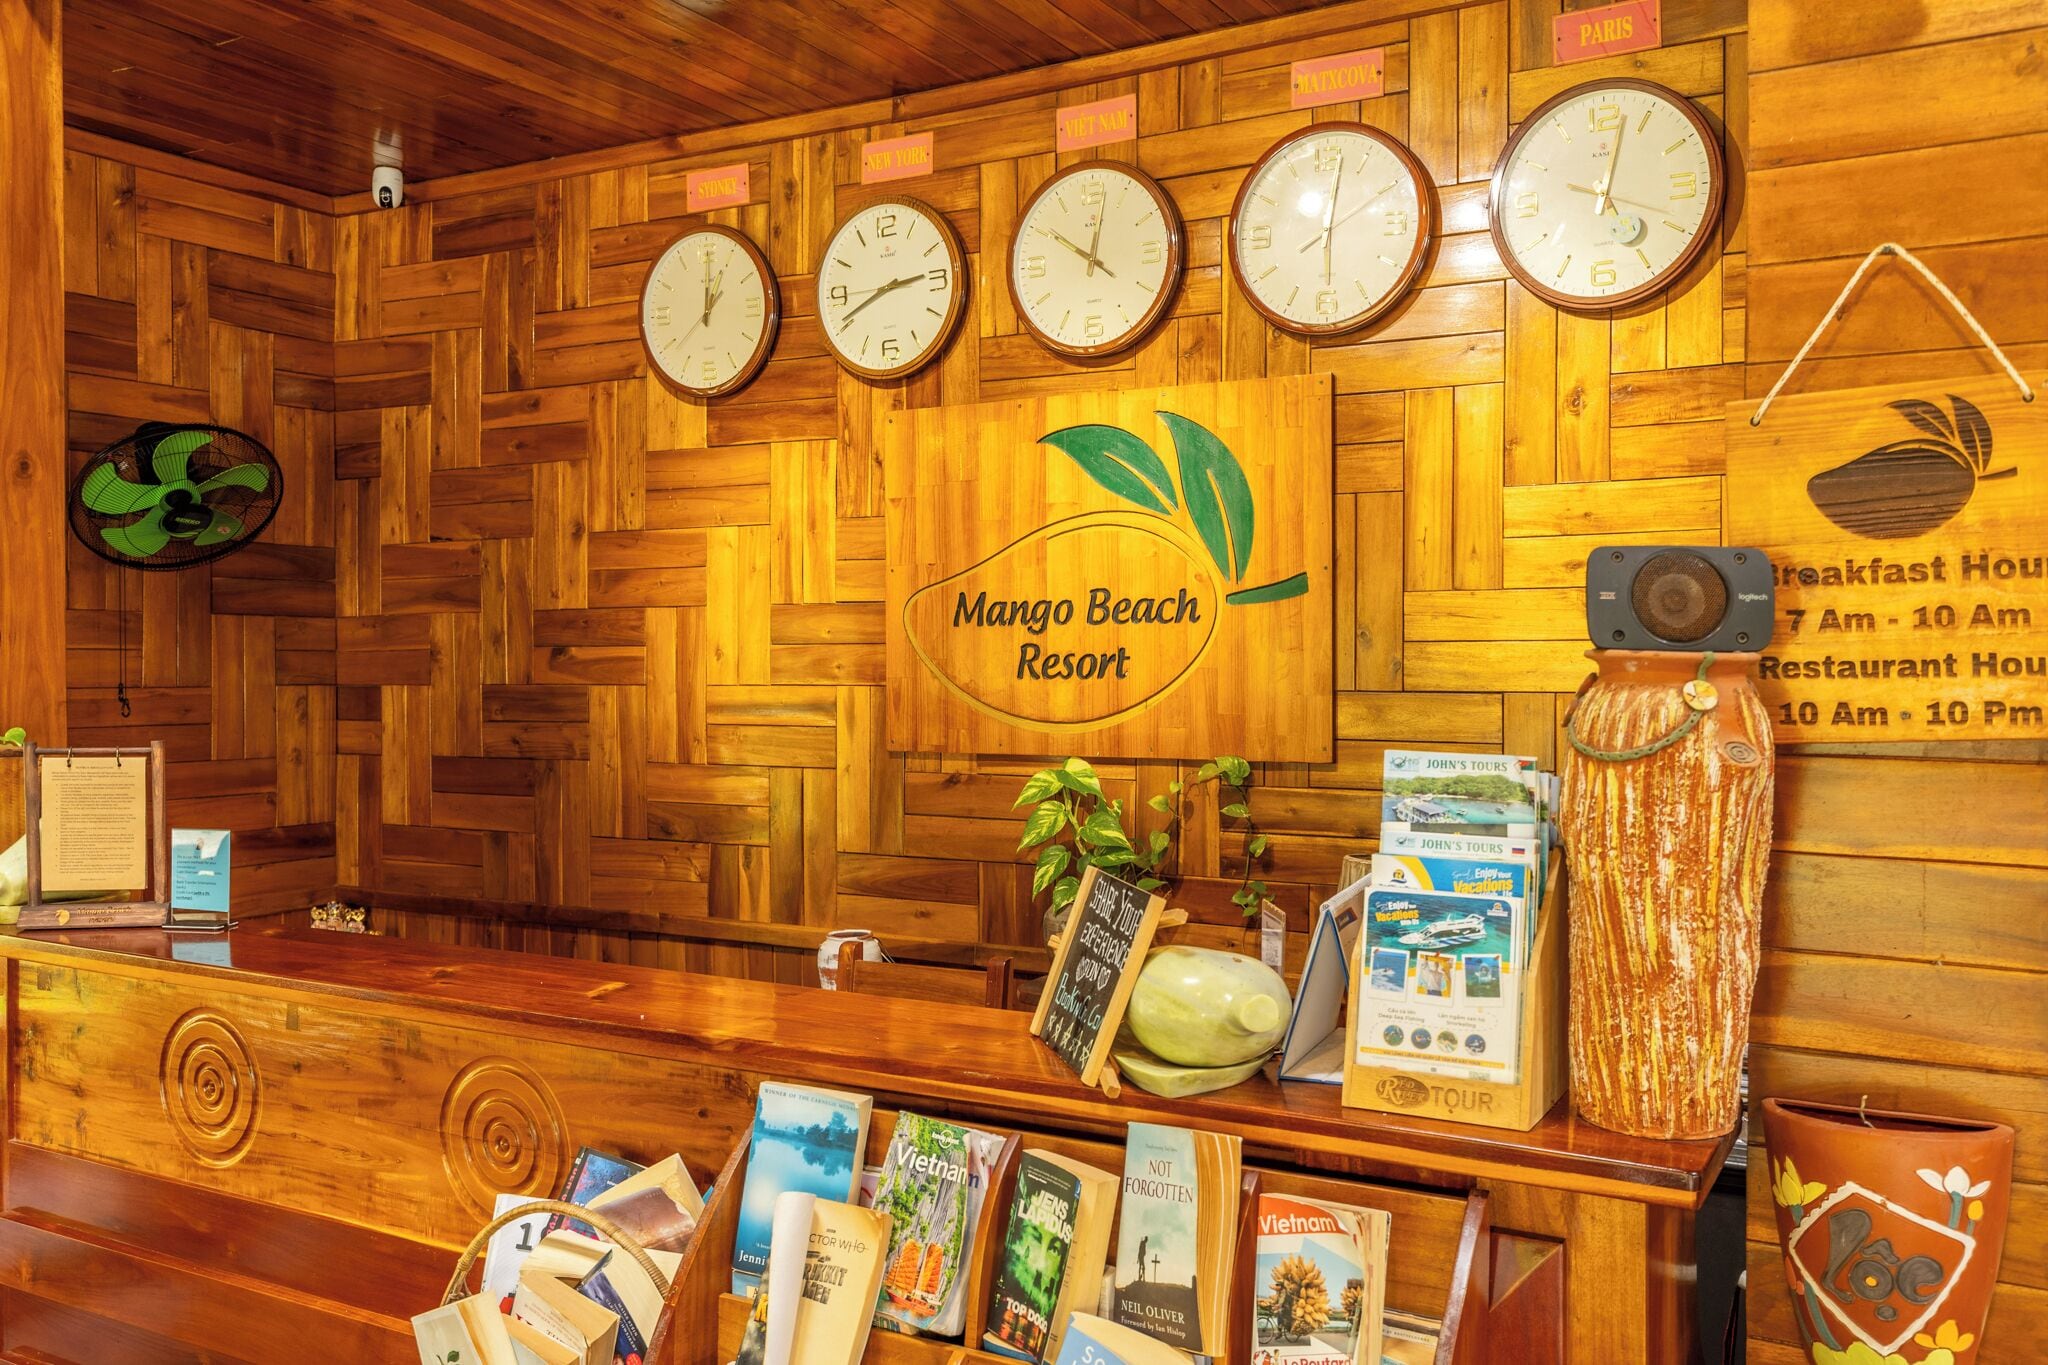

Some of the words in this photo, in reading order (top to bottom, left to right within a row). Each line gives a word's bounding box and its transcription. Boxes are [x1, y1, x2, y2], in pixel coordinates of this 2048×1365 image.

[1579, 15, 1633, 48] PARIS
[1297, 63, 1379, 95] MATXCOVA
[1099, 108, 1128, 133] NAM
[1588, 103, 1621, 133] 12
[866, 151, 893, 172] NEW
[895, 145, 928, 167] YORK
[698, 177, 737, 199] SYDNEY
[1669, 171, 1697, 200] 3
[876, 214, 898, 239] 12
[1384, 210, 1408, 237] 3
[1140, 240, 1162, 265] 3
[928, 268, 949, 293] 3
[1590, 259, 1617, 287] 6
[745, 296, 761, 318] 3
[1314, 289, 1339, 315] 6
[1084, 315, 1104, 338] 6
[881, 338, 901, 362] 6
[703, 361, 717, 381] 6
[1961, 553, 2048, 582] Hou
[1738, 592, 1768, 602] logitech
[952, 590, 1074, 635] Mango
[1086, 587, 1201, 625] Beach
[1785, 609, 1806, 633] 7
[1818, 608, 1876, 633] Am
[1913, 604, 1956, 629] 10
[1969, 603, 2032, 629] Am
[1016, 642, 1131, 680] Resort
[1758, 652, 1958, 680] Restaurant
[1971, 651, 2048, 678] Hou
[1778, 701, 1819, 726] 10
[1830, 701, 1889, 726] Am
[1926, 700, 1969, 726] 10
[1983, 700, 2043, 726] Pm
[1426, 759, 1467, 771] JOHN'S
[1471, 761, 1508, 772] TOURS
[1419, 838, 1462, 851] JOHN'S
[1466, 842, 1504, 854] TOURS
[1475, 867, 1498, 879] Enjoy
[1453, 879, 1514, 894] Vacations
[1089, 877, 1119, 924] SHARE
[1388, 901, 1409, 910] Enjoy
[1375, 909, 1420, 922] Vacations
[764, 1088, 787, 1098] WINNER
[798, 1094, 810, 1102] THE
[810, 1096, 838, 1108] CARNEGIE
[1430, 1086, 1494, 1113] TOUR
[897, 1141, 980, 1190] Vietnam
[1148, 1159, 1173, 1178] NOT
[1124, 1177, 1194, 1204] FORGOTTEN
[1031, 1189, 1070, 1221] JENS
[1017, 1198, 1073, 1245] LAPIDUS
[1260, 1213, 1337, 1235] Vietnam
[808, 1233, 837, 1247] CTOR
[839, 1239, 870, 1254] WHO
[738, 1249, 767, 1266] Jenni
[802, 1263, 848, 1287] RIKKIT
[1006, 1297, 1028, 1316] TOP
[1120, 1299, 1144, 1316] NEIL
[1145, 1305, 1186, 1325] OLIVER
[1120, 1315, 1147, 1330] Foreword
[1147, 1322, 1155, 1333] by
[1155, 1324, 1166, 1333] Ian
[1166, 1326, 1187, 1340] Hislop
